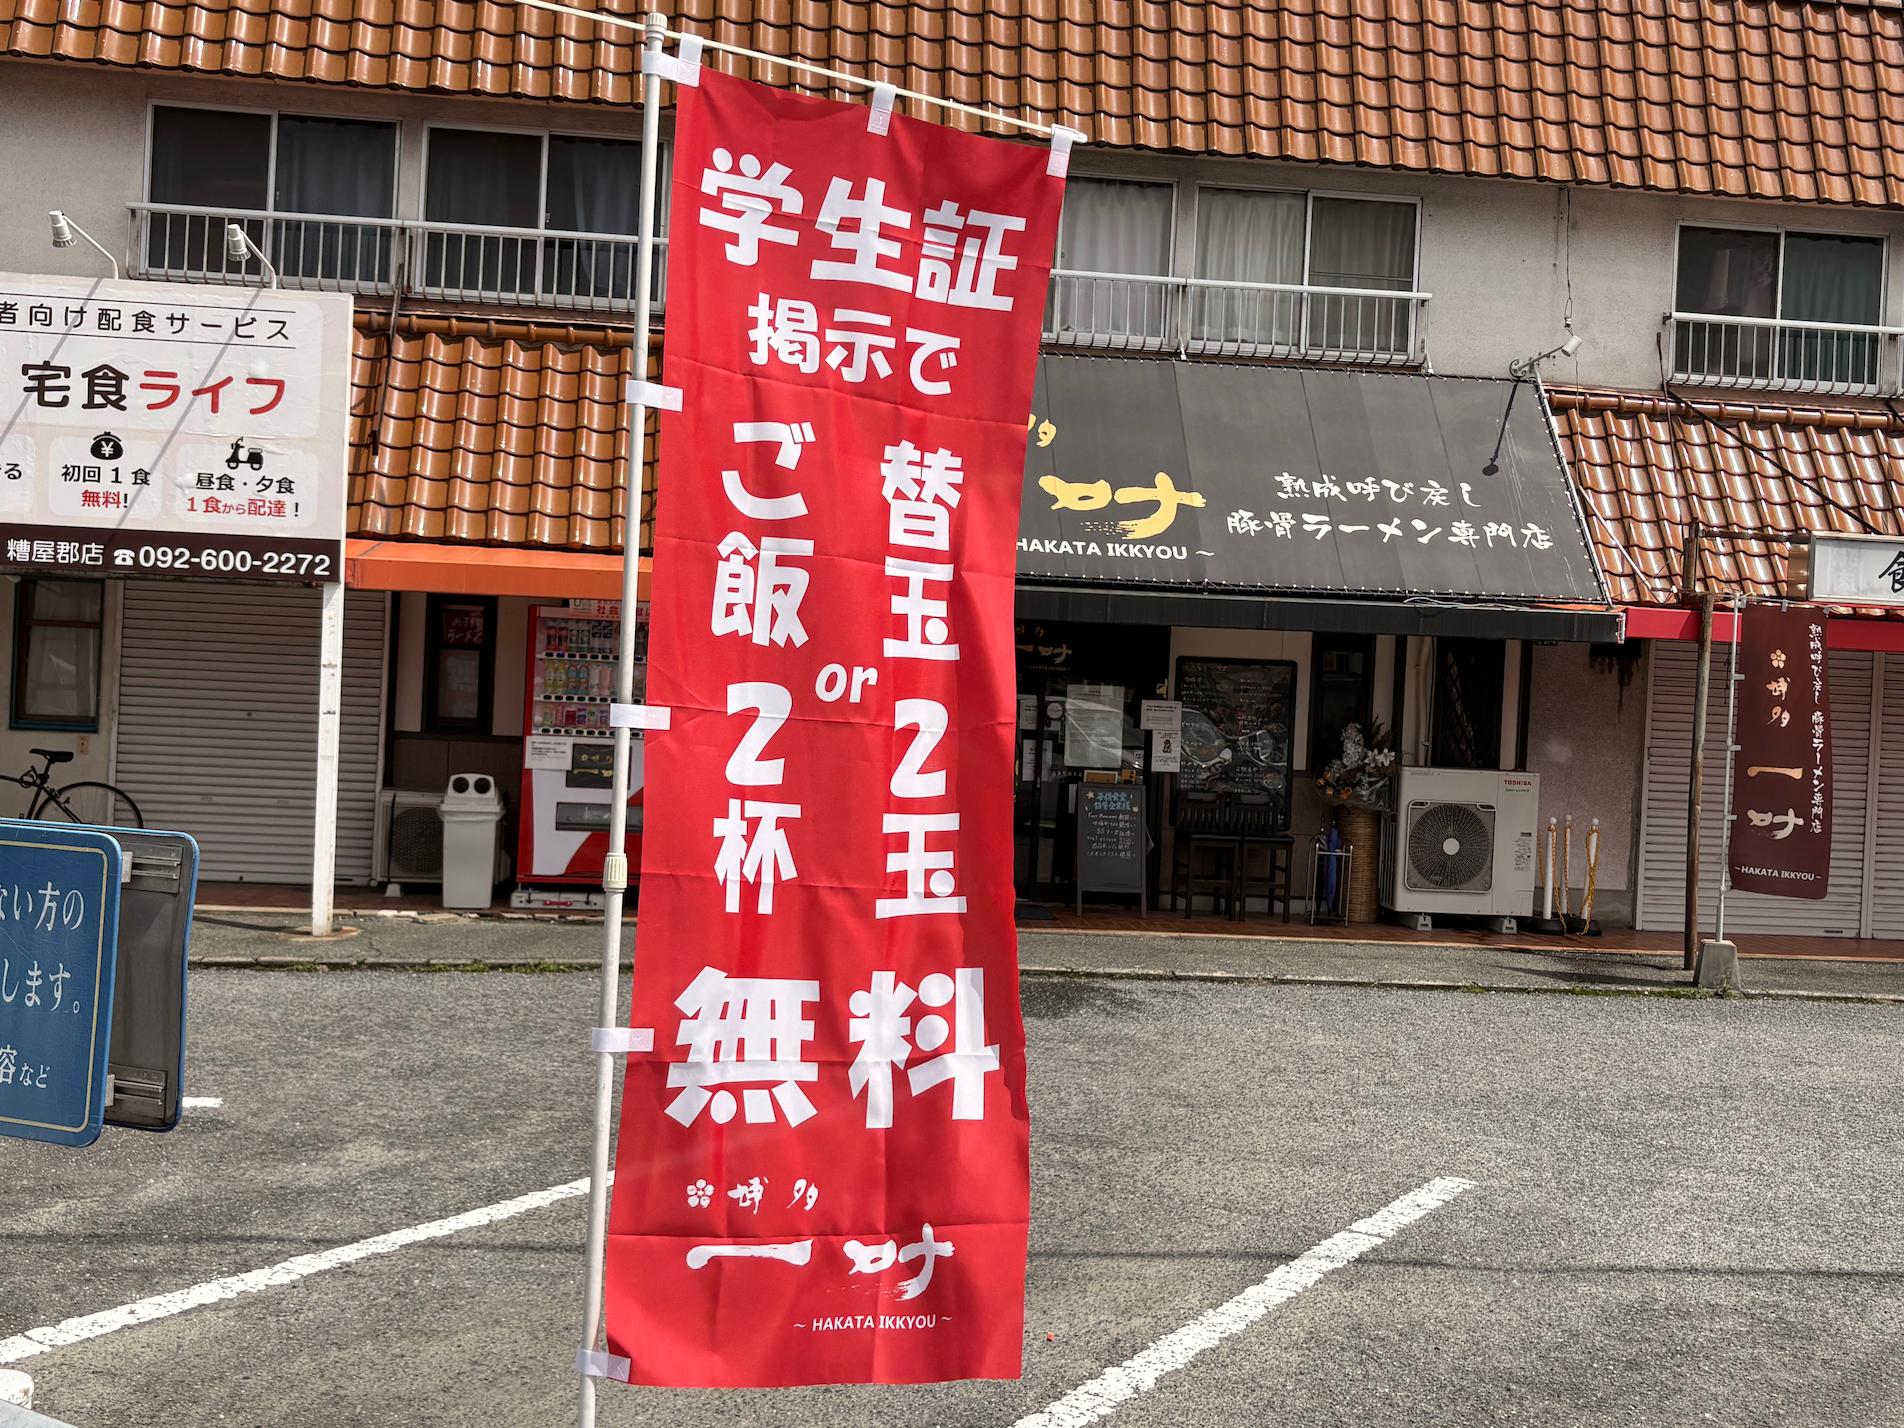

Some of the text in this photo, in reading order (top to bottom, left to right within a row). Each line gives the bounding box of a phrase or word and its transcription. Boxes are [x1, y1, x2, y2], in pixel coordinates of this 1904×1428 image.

[699, 147, 1027, 312] 学生証
[748, 291, 961, 396] 掲示で
[22, 360, 286, 415] 宅食ライフ
[0, 462, 22, 480] る
[195, 472, 296, 495] 昼食・夕食
[1273, 472, 1481, 508] 熟成呼び戻し
[1016, 537, 1188, 560] HAKATA IKKYOU
[1226, 509, 1554, 550] 豚骨ラーメン専門店
[7, 538, 332, 576] 糟屋郡店 092-600-2272
[815, 662, 878, 703] or
[1741, 866, 1815, 881] HAKATA IKKYOU
[664, 965, 1000, 1129] 無料
[812, 1314, 937, 1331] HAKATA IKKYOU
